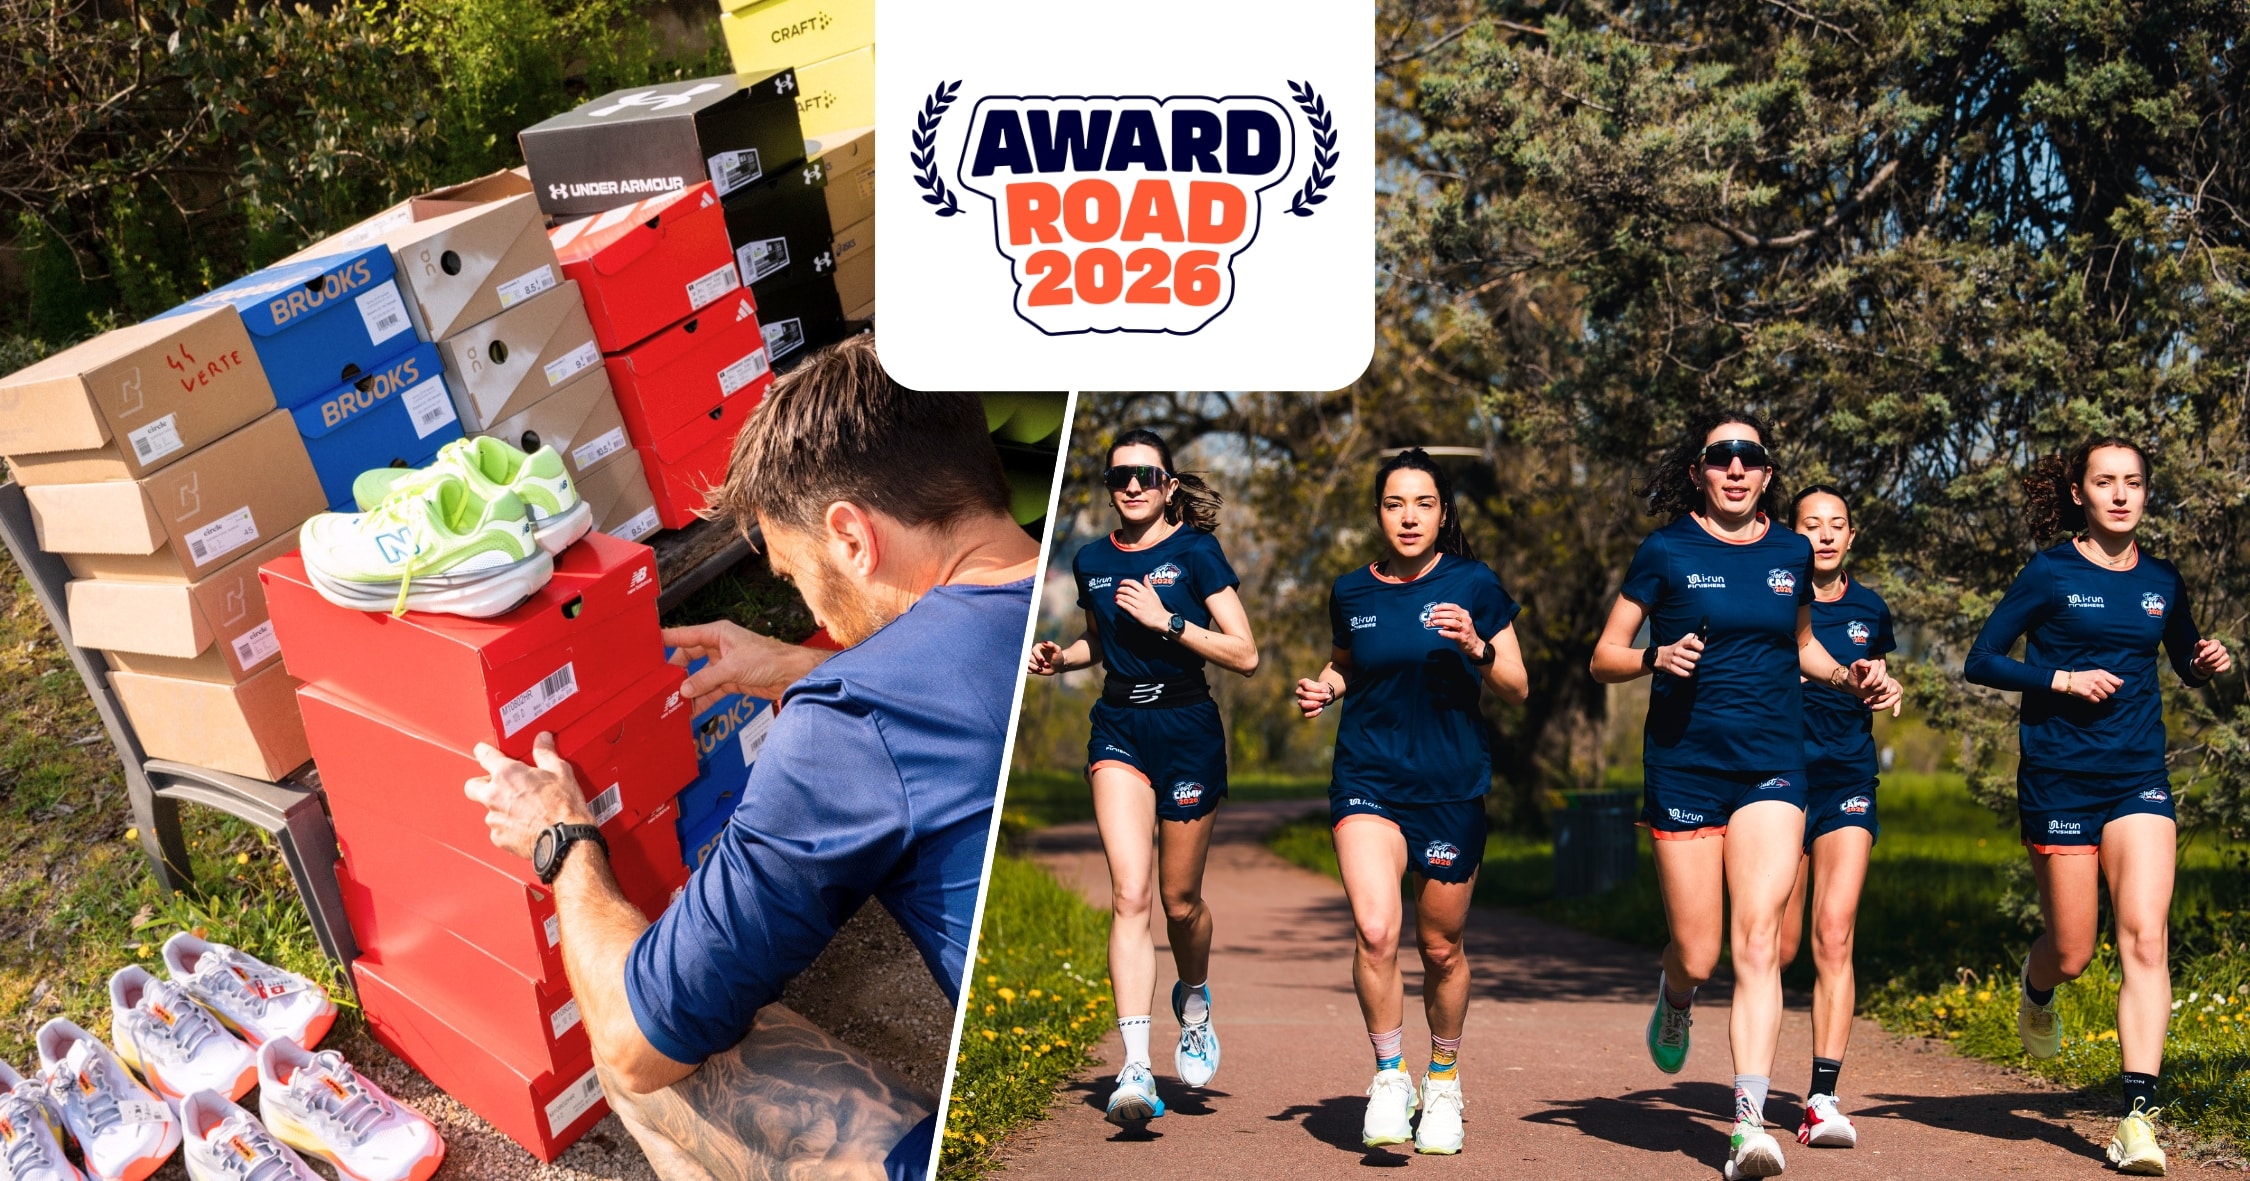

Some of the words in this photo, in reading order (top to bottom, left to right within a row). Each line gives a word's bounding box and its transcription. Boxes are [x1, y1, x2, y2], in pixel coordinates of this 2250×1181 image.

[771, 17, 817, 43] CRAFT
[798, 96, 821, 112] AFT
[570, 180, 618, 197] UNDER
[620, 176, 686, 193] ARMOUR
[269, 258, 371, 325] BROOKS
[166, 343, 195, 372] 44
[181, 350, 242, 392] VERTE
[321, 357, 420, 428] BROOKS
[147, 420, 168, 434] circle
[203, 523, 223, 537] circle
[243, 526, 254, 537] 45
[1149, 570, 1178, 579] CAMP
[1701, 573, 1725, 583] i-run
[635, 578, 653, 591] balance
[1769, 578, 1794, 588] CAMP
[2082, 594, 2104, 603] i-run
[250, 626, 268, 640] circle
[1174, 790, 1201, 800] CAMP
[1682, 810, 1703, 822] i-run
[2060, 820, 2081, 829] i-run
[1426, 849, 1457, 860] CAMP
[1430, 857, 1451, 866] 2026
